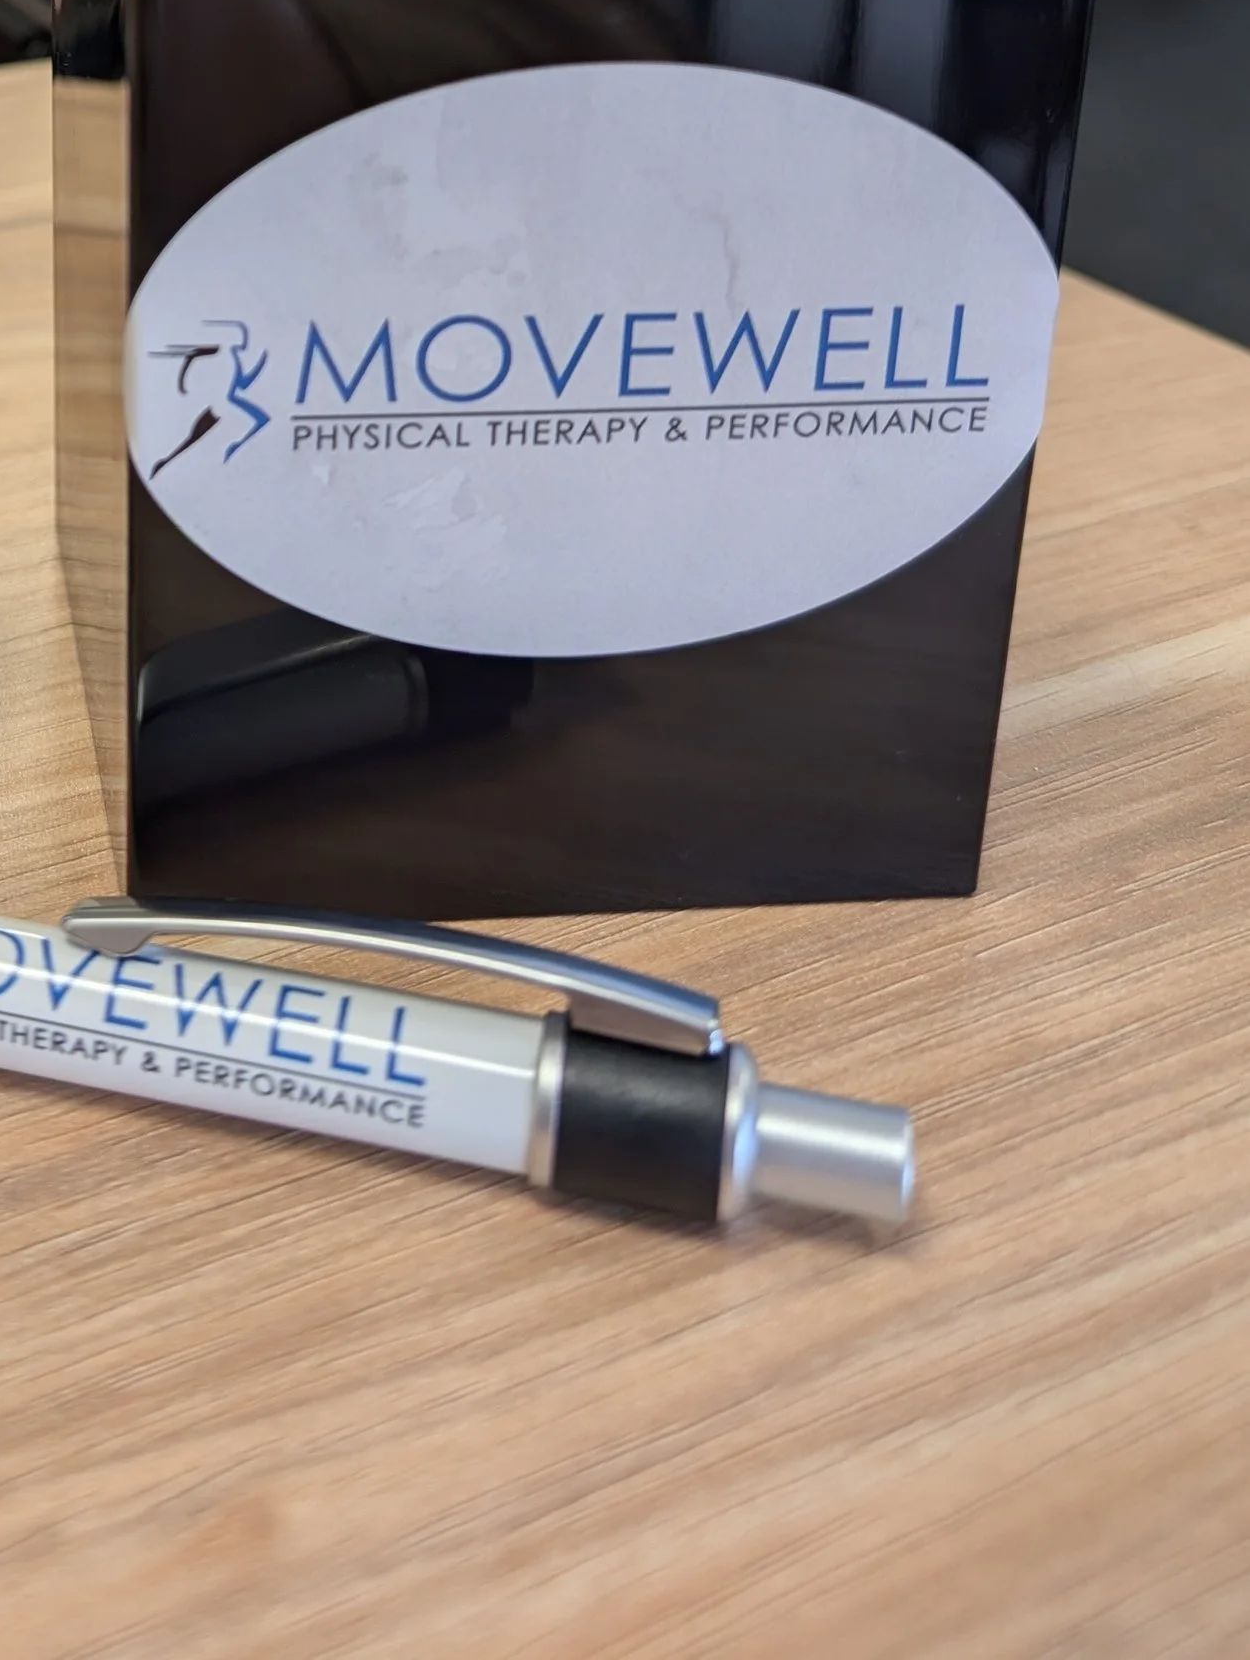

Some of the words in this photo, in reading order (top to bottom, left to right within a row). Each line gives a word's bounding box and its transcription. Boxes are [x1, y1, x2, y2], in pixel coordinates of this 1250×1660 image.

[294, 304, 989, 404] MOVEWELL
[292, 420, 470, 451] PHYSICAL
[486, 415, 647, 447] THERAPY
[664, 416, 688, 442] &
[706, 405, 987, 441] PERFORMANCE
[141, 1050, 161, 1073] &
[175, 1058, 426, 1128] PERFORMANCE
